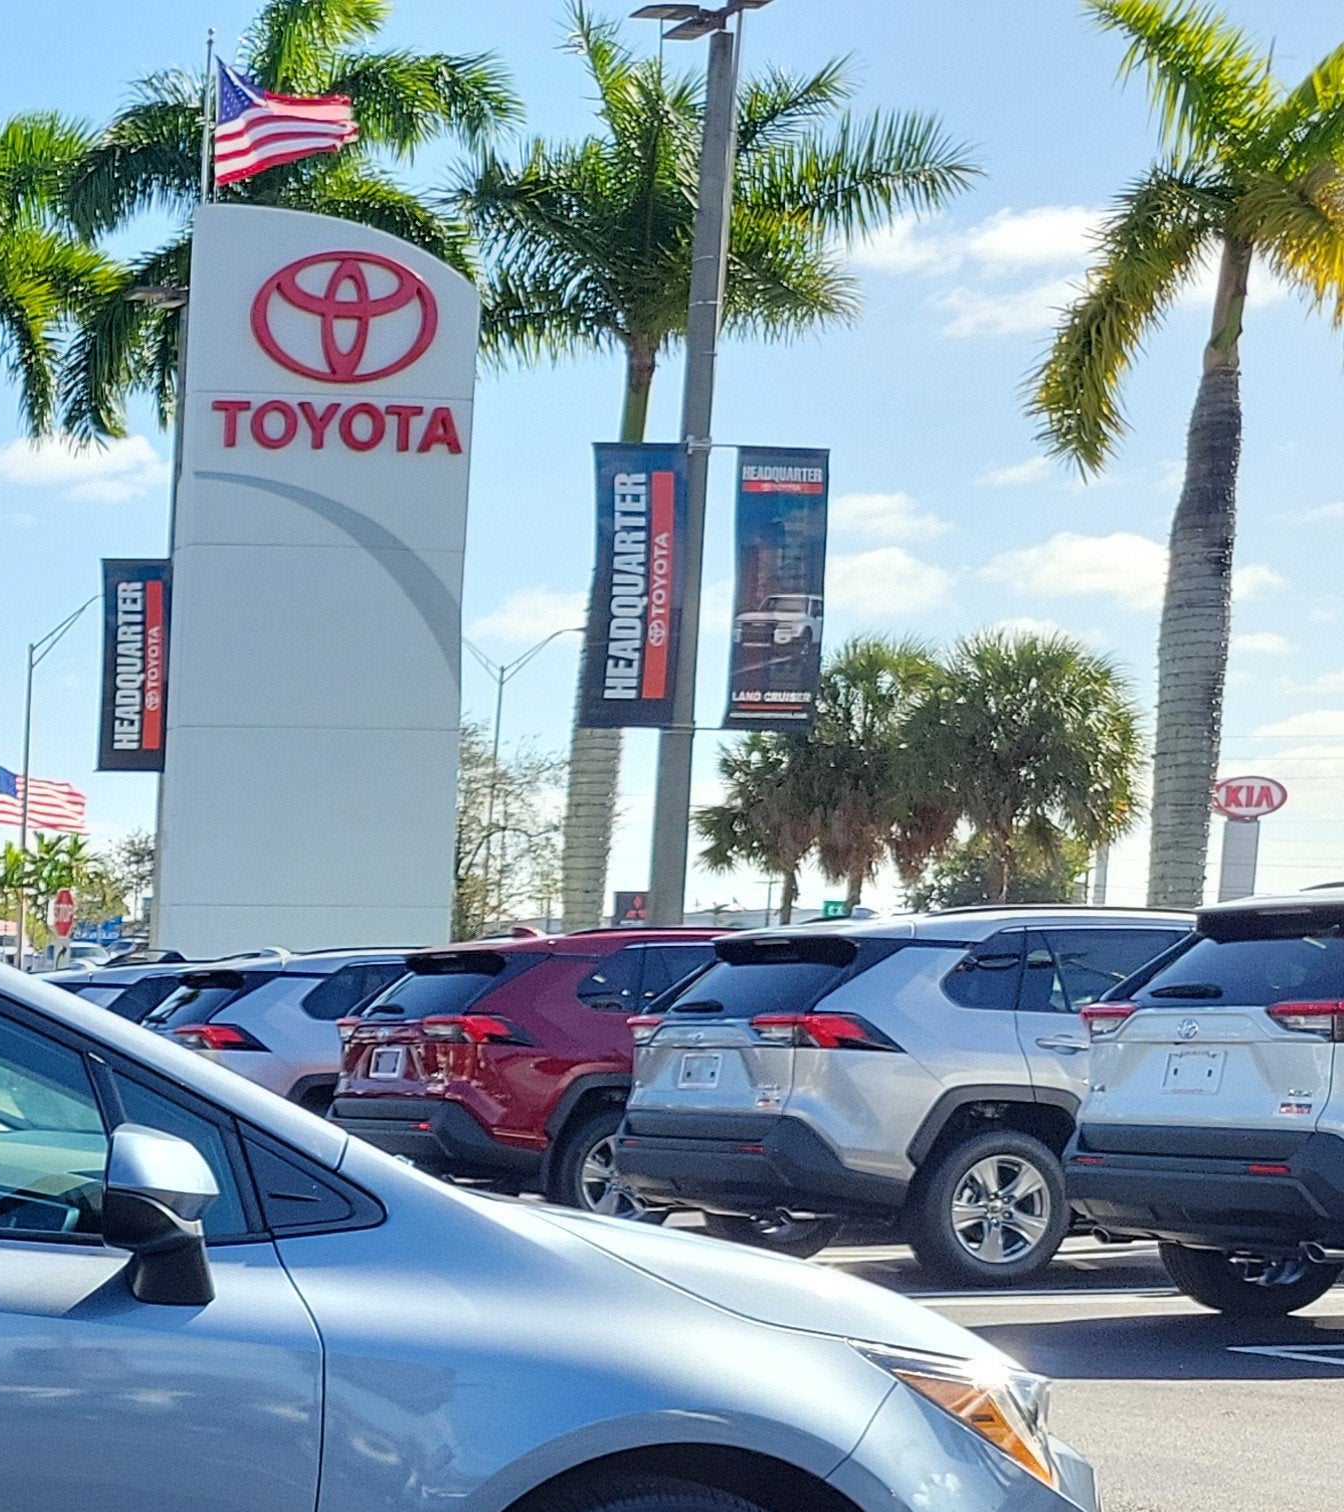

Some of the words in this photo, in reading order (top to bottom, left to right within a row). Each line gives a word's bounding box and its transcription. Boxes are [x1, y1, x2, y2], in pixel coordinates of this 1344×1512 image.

[212, 400, 463, 455] TOYOTA
[742, 465, 823, 483] HEADQUARTER
[603, 472, 648, 699] HEADQUARTER
[652, 532, 670, 618] TOYOTA
[113, 581, 144, 751] HEADQUARTER
[146, 626, 163, 689] TOYOTA
[732, 691, 762, 701] LAND
[1224, 785, 1274, 808] KIA
